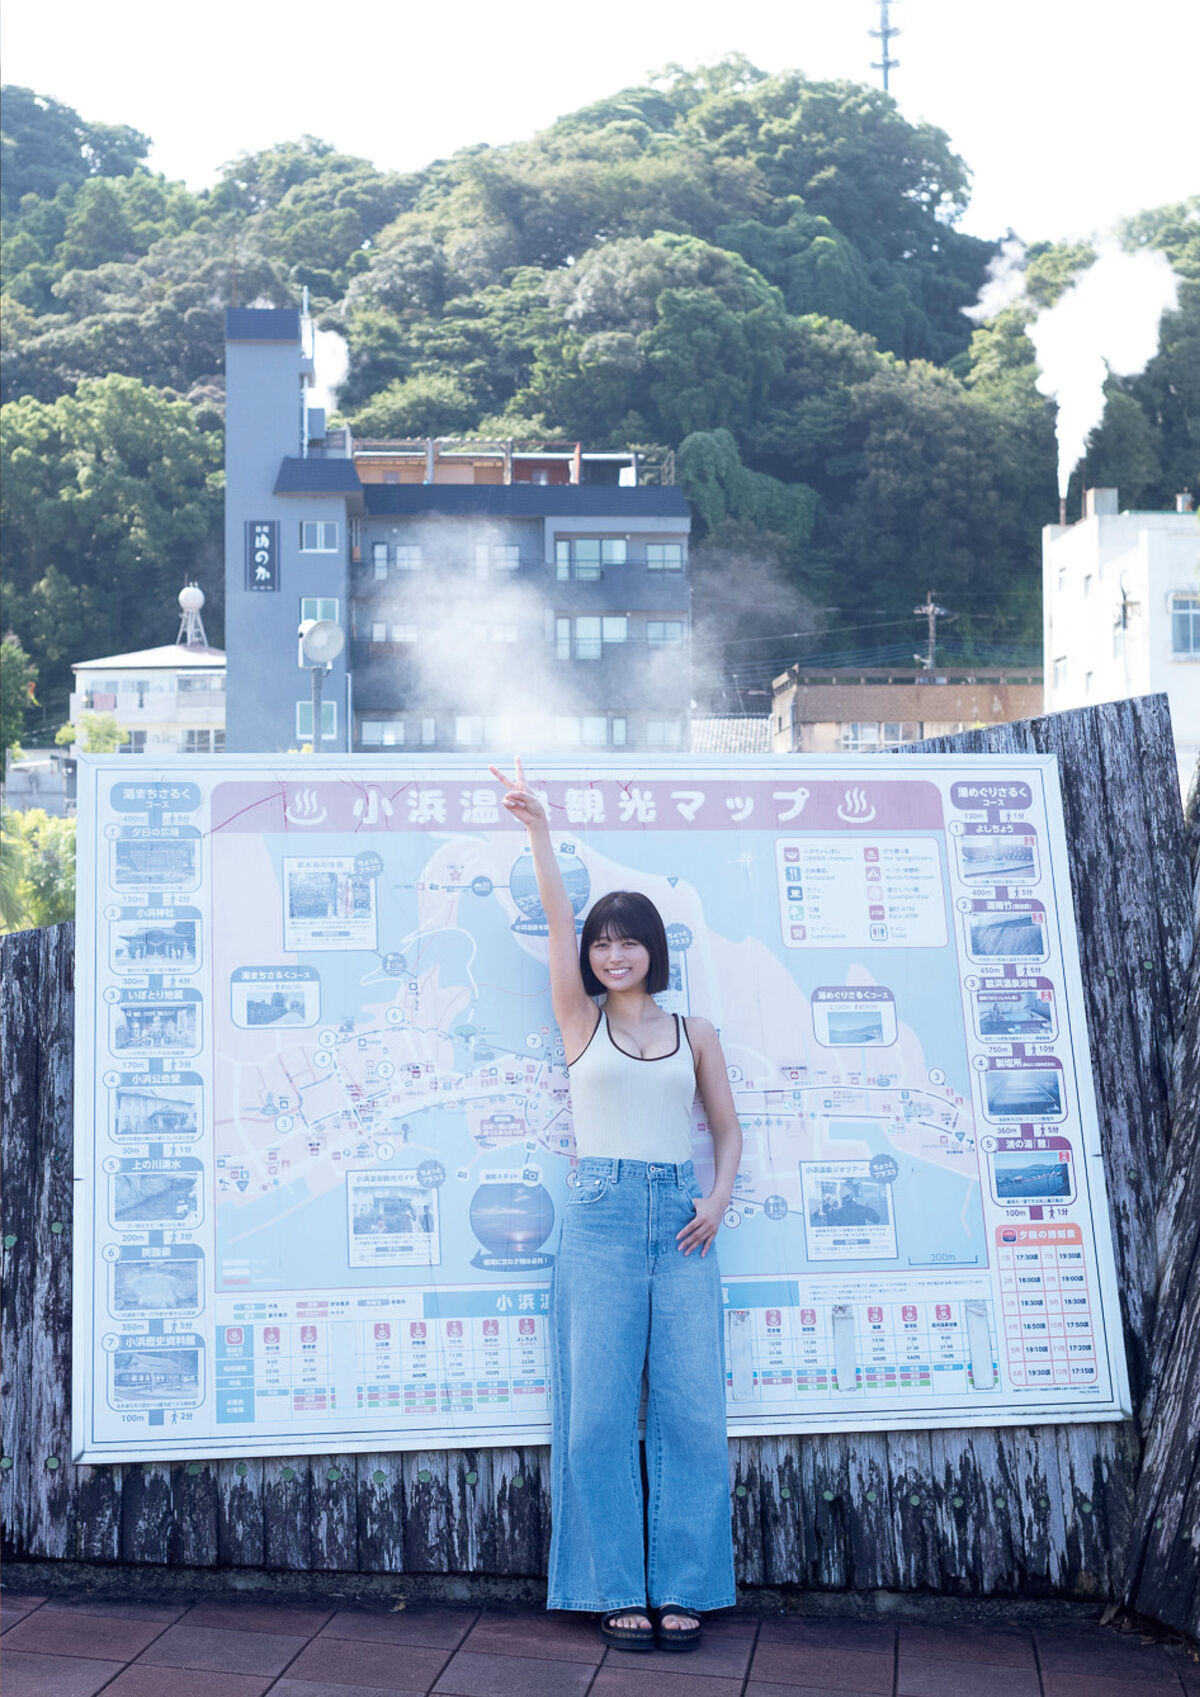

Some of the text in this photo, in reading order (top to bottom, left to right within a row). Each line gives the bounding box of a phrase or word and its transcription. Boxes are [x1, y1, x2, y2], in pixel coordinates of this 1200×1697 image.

[144, 800, 170, 809] コース
[353, 786, 811, 826] 小浜温観光マップ
[982, 799, 1006, 807] コース
[976, 825, 1014, 833] よしちょう
[137, 908, 175, 919] 小浜神社
[1005, 1209, 1026, 1217] 100m
[931, 1253, 956, 1262] 200m
[121, 1323, 144, 1331] 350m
[125, 1335, 197, 1348] 小浜歴史資料館
[121, 1414, 145, 1422] 100m
